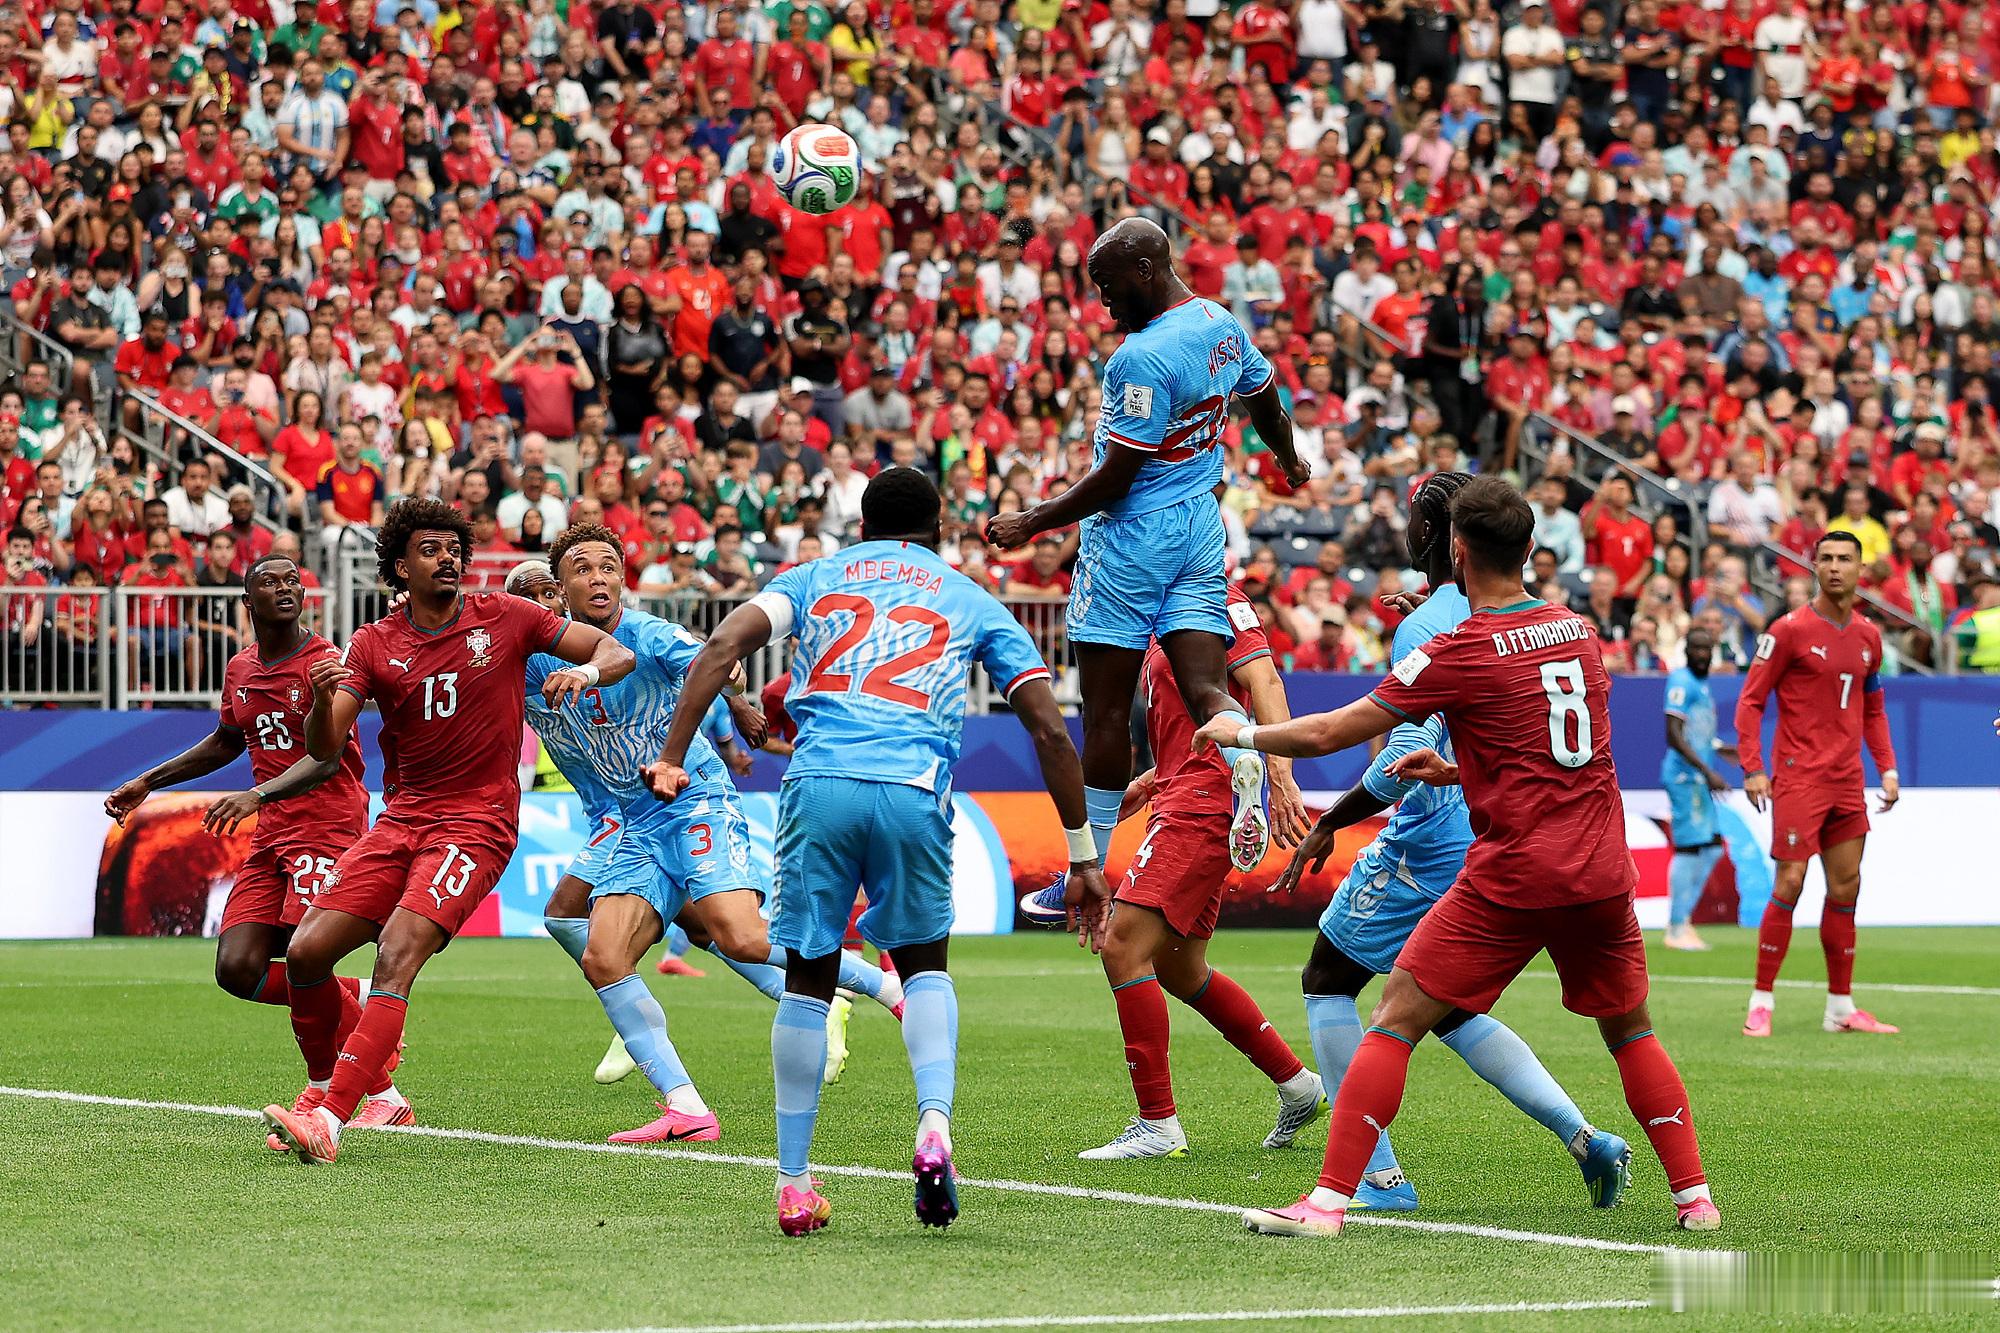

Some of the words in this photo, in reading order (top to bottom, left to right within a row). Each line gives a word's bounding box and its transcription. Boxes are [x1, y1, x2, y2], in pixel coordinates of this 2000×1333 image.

[845, 560, 944, 597] MBEMBA
[804, 593, 951, 713] 22
[422, 672, 459, 721] 13
[584, 688, 608, 726] 3
[1839, 672, 1853, 710] 7
[256, 711, 294, 750] 25
[1539, 657, 1594, 768] 8
[589, 817, 621, 847] 7
[687, 822, 713, 857] 3
[293, 854, 335, 895] 25
[431, 843, 477, 897] 13
